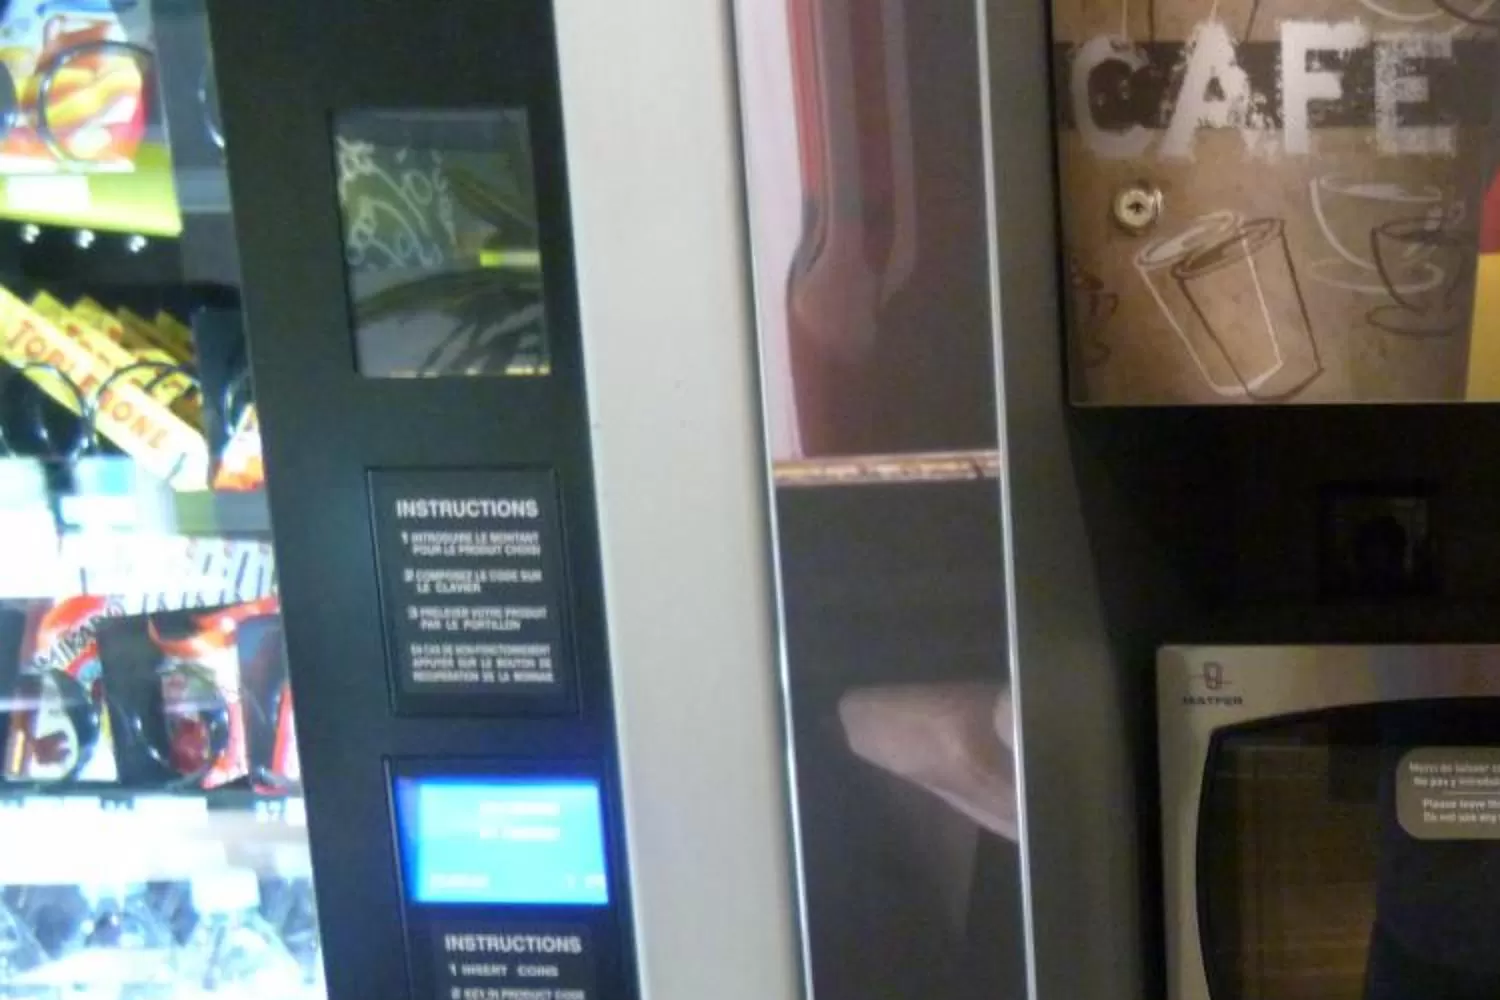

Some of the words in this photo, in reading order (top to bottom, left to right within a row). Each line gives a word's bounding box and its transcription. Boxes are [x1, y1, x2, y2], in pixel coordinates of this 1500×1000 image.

[1068, 16, 1457, 162] CAFE
[395, 499, 539, 518] INSTRUCTIONS
[444, 934, 582, 954] INSTRUCTIONS
[461, 963, 508, 977] INSERT
[516, 964, 559, 977] COINS
